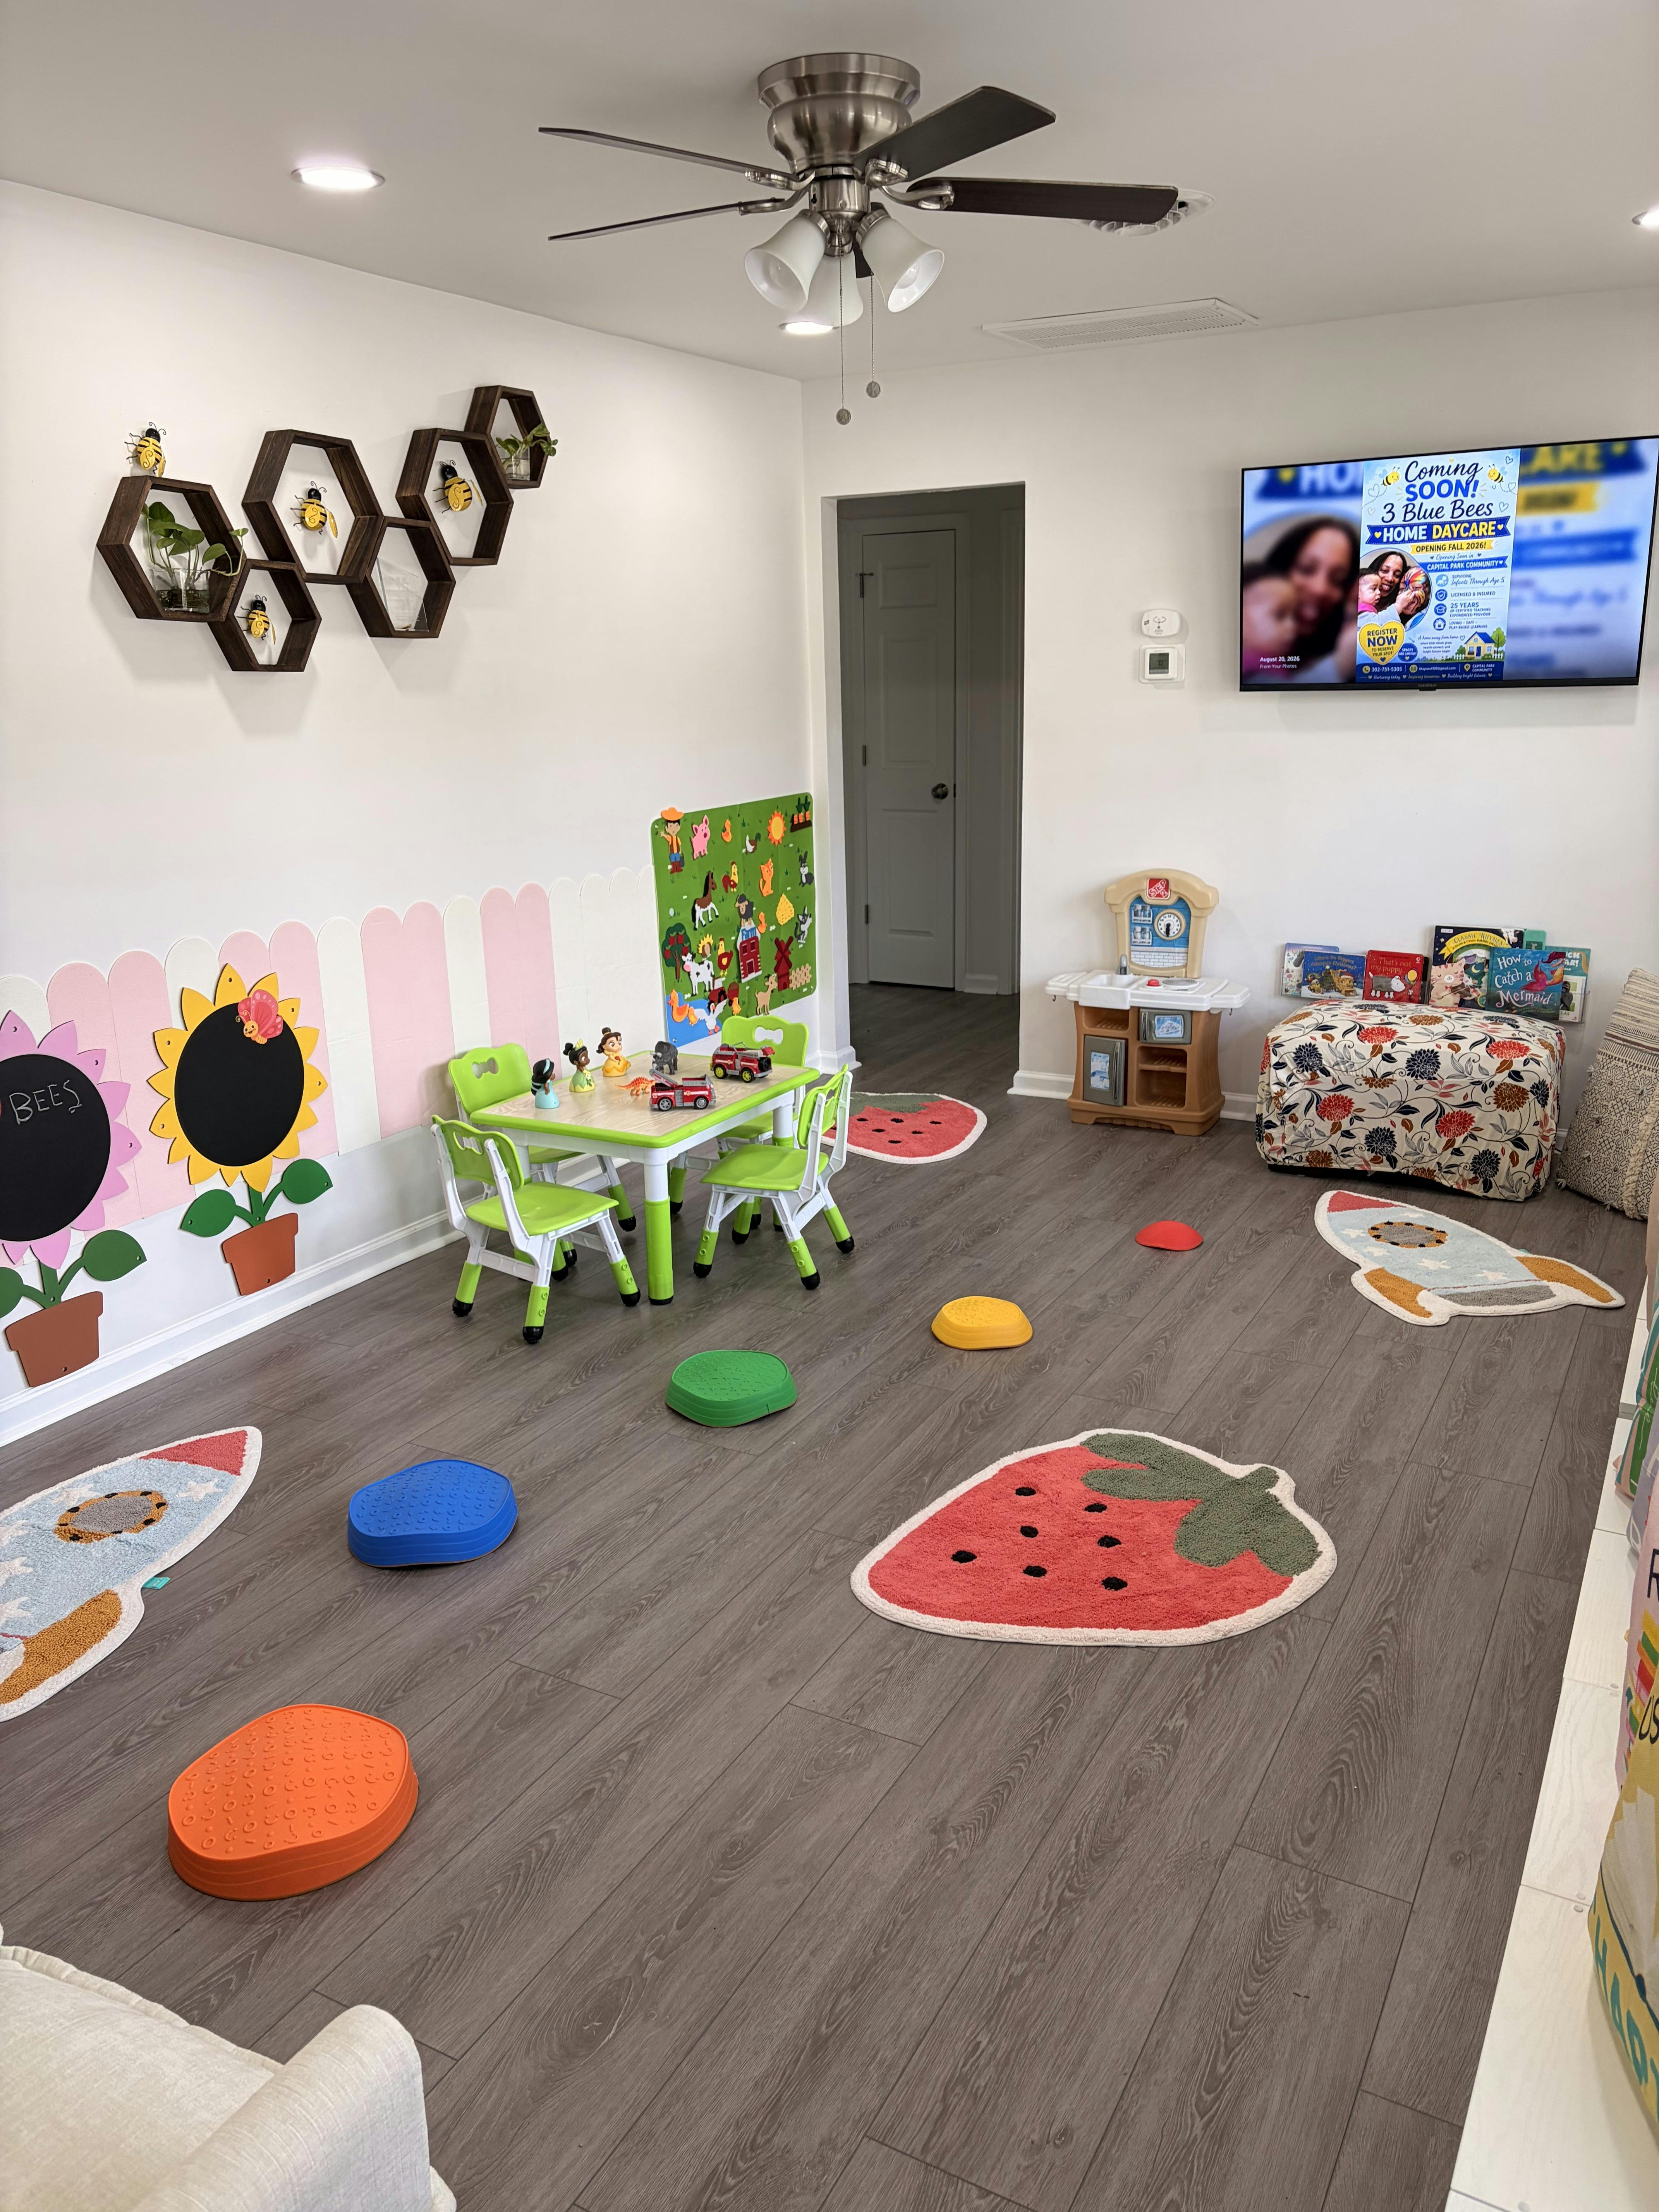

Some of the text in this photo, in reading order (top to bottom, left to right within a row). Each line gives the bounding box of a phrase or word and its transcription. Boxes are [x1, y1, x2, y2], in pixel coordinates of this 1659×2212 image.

[1405, 460, 1483, 484] Coming
[1405, 479, 1479, 502] SOON!
[1381, 499, 1494, 523] 3 Blue Bees
[1383, 521, 1496, 542] HOME DAYCARE
[1416, 544, 1446, 553] OPENING
[1466, 560, 1498, 568] COMMUNITY
[1470, 577, 1489, 586] Through
[1490, 577, 1499, 585] Age
[1367, 628, 1397, 637] REGISTER
[1367, 635, 1398, 647] NOW
[1149, 879, 1166, 897] STEP
[1160, 889, 1168, 898] 2
[741, 927, 757, 941] Farm
[1454, 933, 1503, 945] CLASSIC RHYMES
[1379, 957, 1398, 966] That's
[1497, 954, 1521, 970] How
[1494, 968, 1532, 988] Catch a
[1496, 990, 1553, 1008] Mermaid
[9, 1079, 82, 1125] BEES
